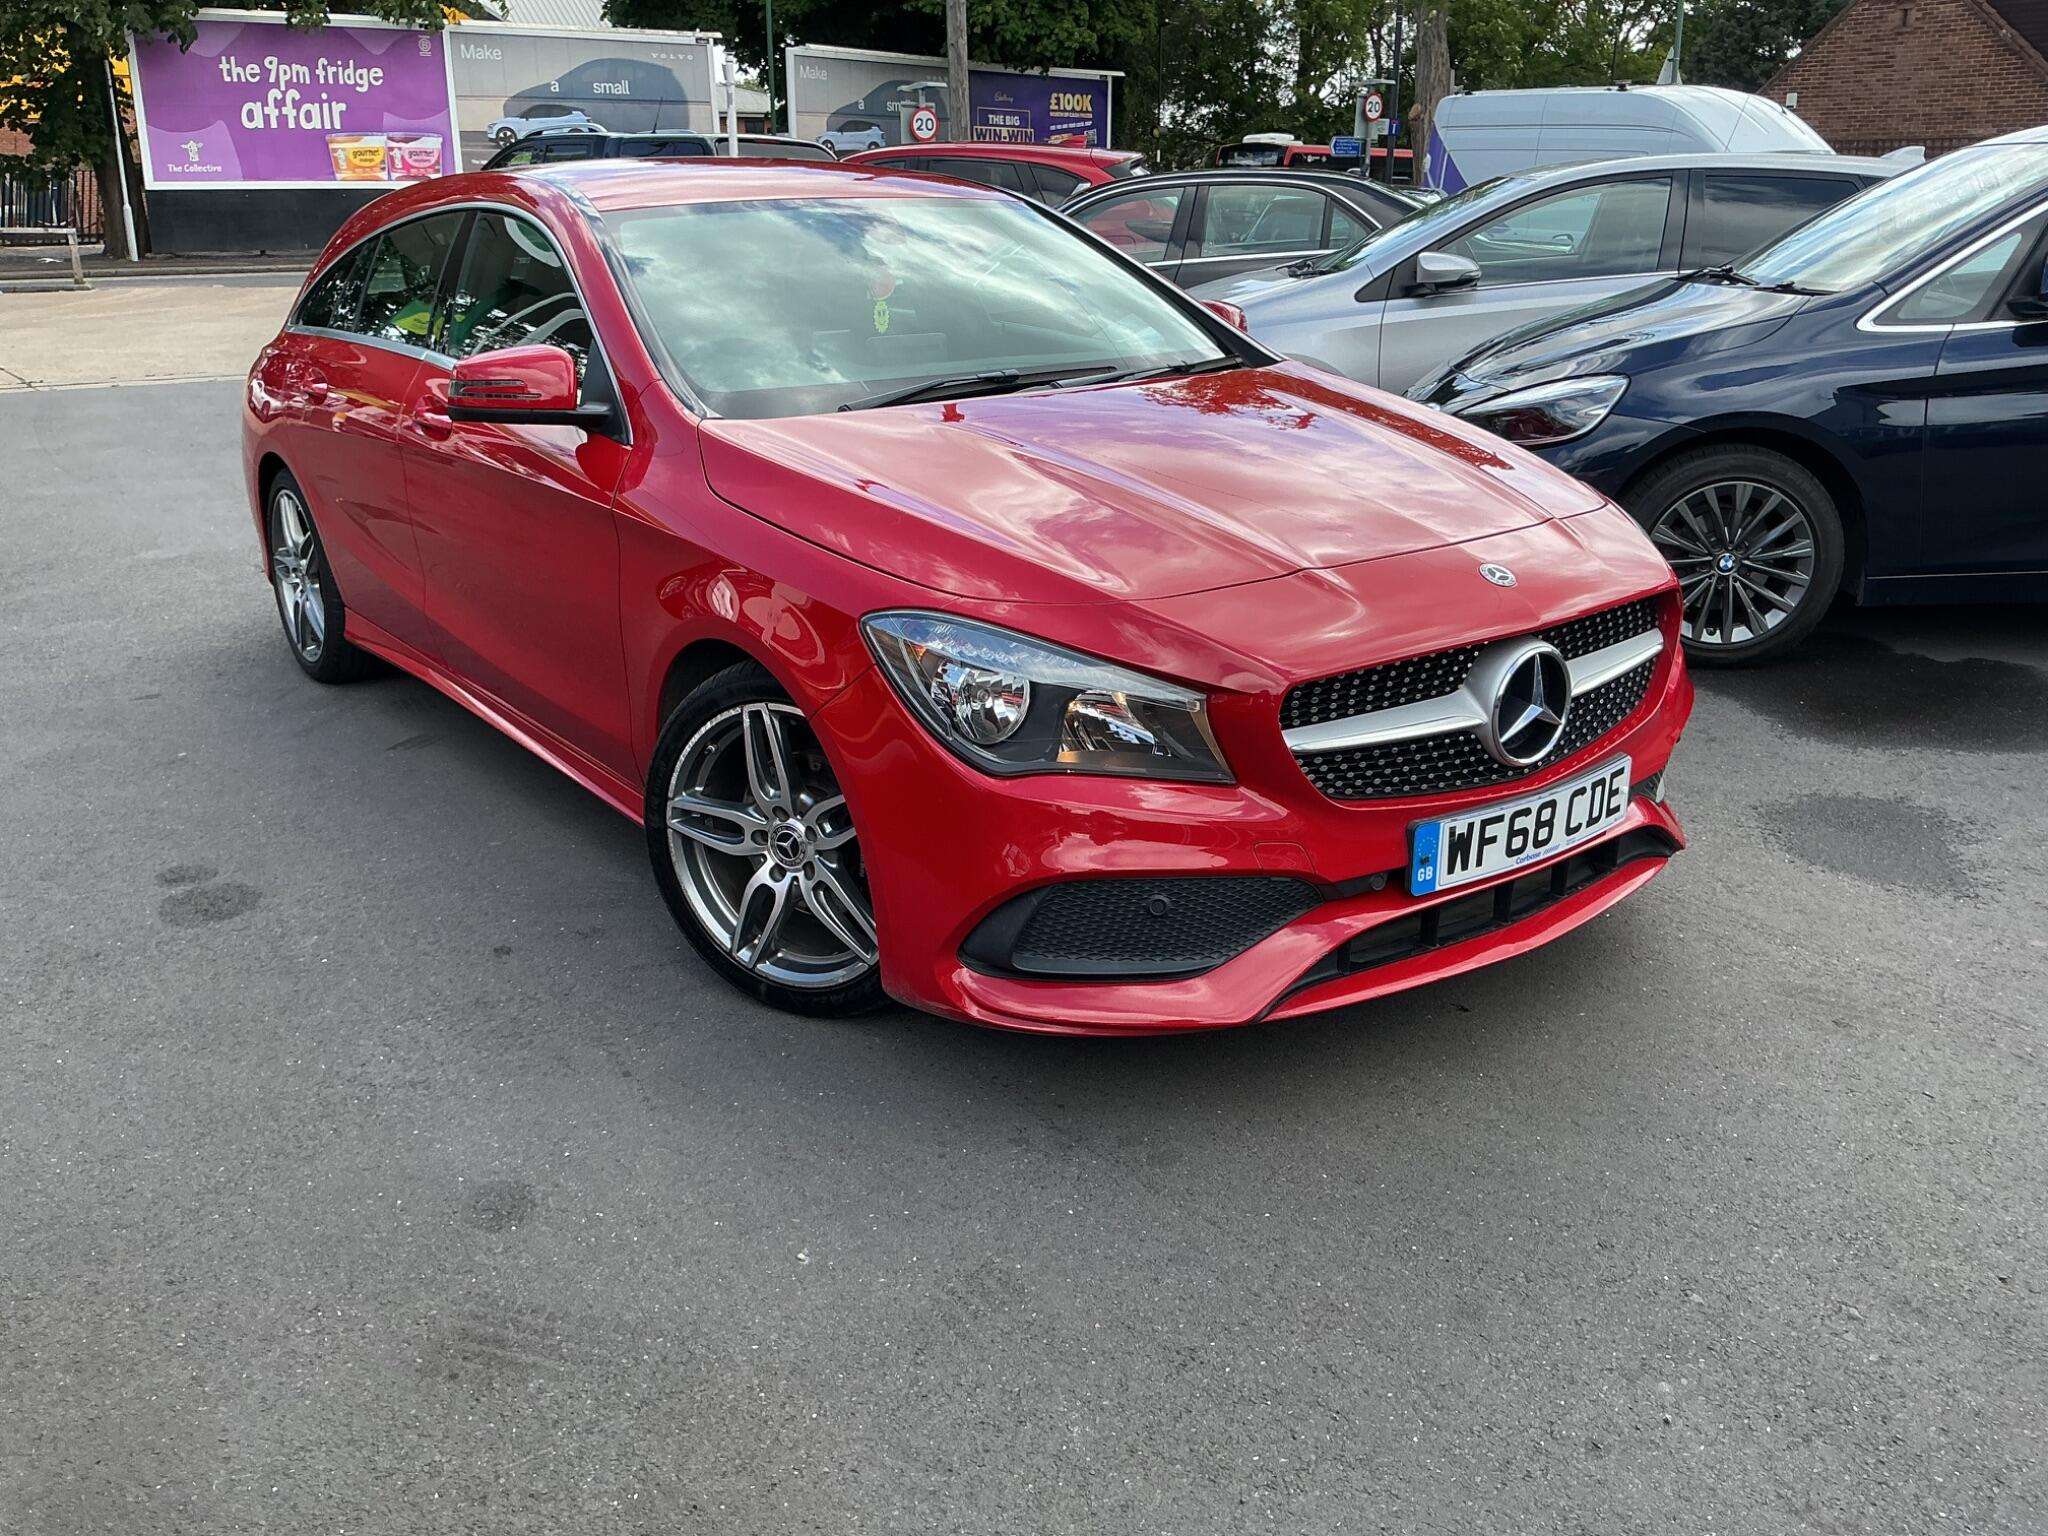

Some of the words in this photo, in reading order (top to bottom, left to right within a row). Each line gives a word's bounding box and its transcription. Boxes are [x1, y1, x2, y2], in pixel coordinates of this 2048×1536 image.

[460, 44, 502, 61] Make
[651, 52, 694, 61] VOLVO
[218, 56, 261, 82] the
[264, 56, 310, 91] 9pm
[316, 58, 384, 93] fridge
[800, 65, 828, 80] Make
[550, 80, 560, 92] a
[592, 79, 630, 95] small
[240, 88, 347, 130] affair
[857, 100, 865, 110] a
[1049, 93, 1092, 111] £100K
[1367, 101, 1381, 114] 20
[915, 117, 935, 132] 20
[988, 114, 1005, 125] THE
[1005, 115, 1020, 126] BIG
[974, 127, 1034, 143] WIN-WIN
[167, 163, 183, 173] The
[1446, 798, 1557, 876] WF68
[1565, 766, 1626, 837] CDE
[1417, 865, 1434, 882] GB
